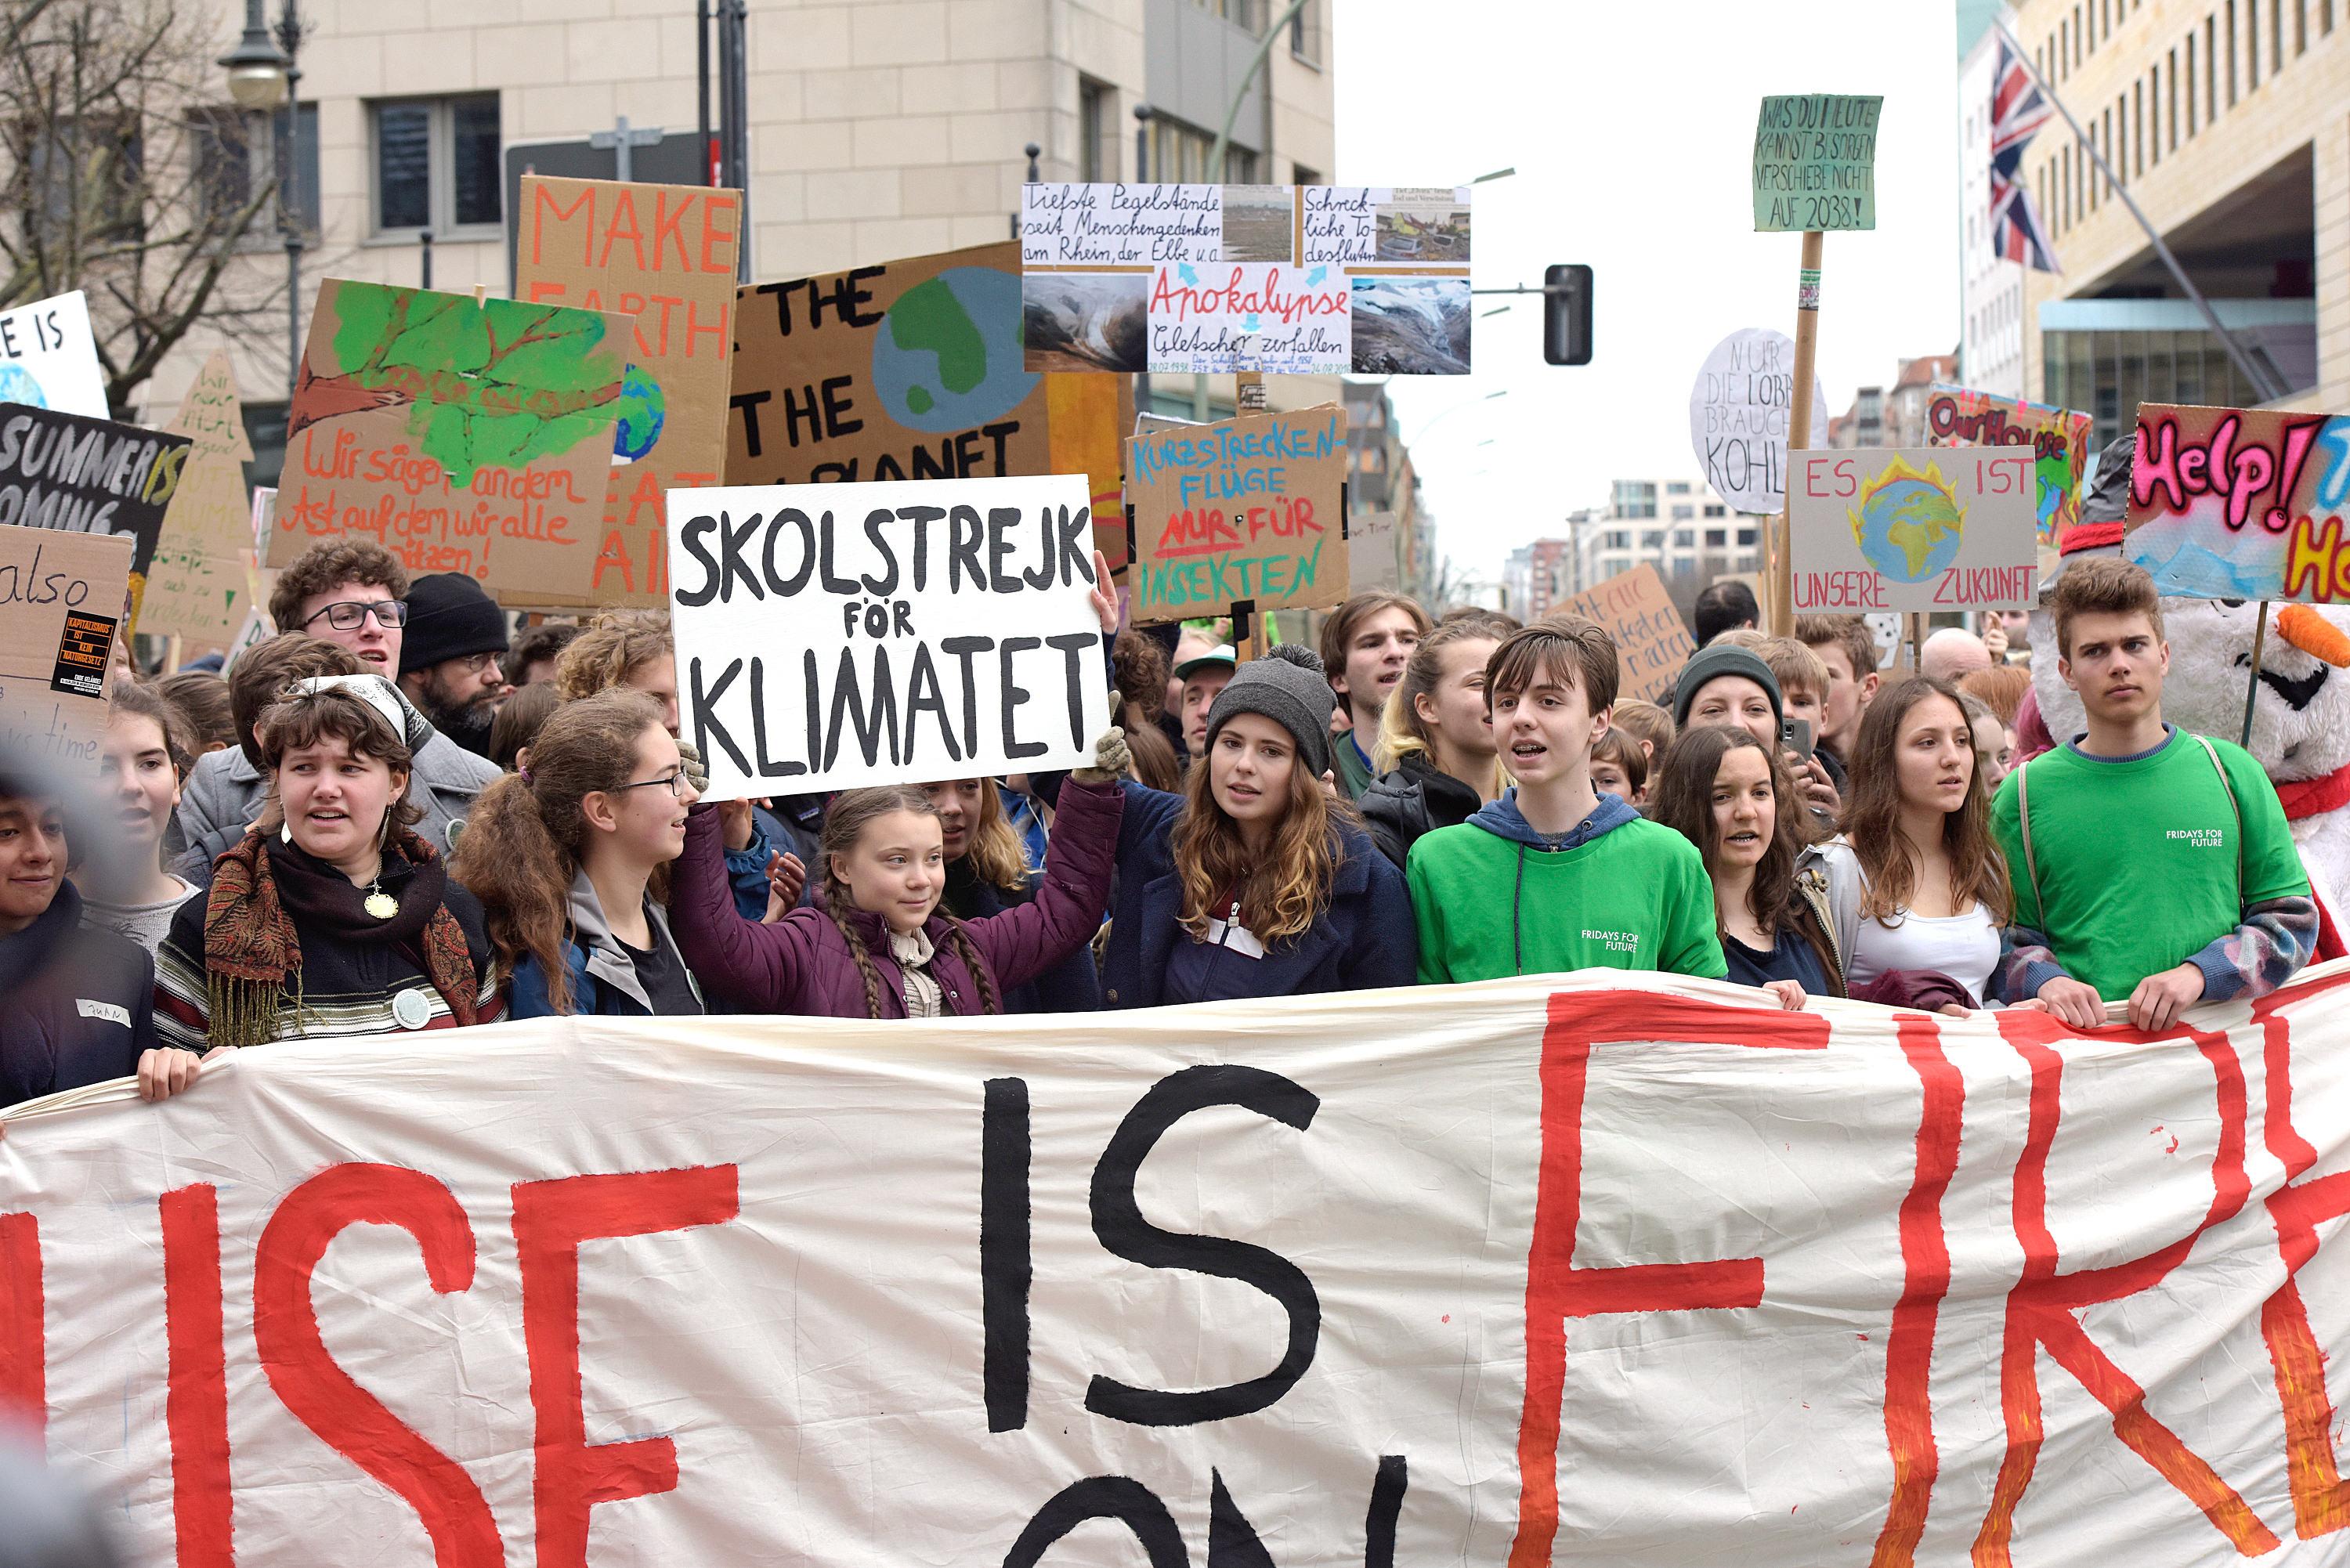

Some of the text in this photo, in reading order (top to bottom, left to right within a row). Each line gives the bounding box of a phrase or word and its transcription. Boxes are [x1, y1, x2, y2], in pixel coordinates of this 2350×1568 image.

[1763, 97, 1794, 128] WAS
[1798, 97, 1818, 128] DU
[1755, 131, 1875, 161] KANNST BESORGEN
[1755, 164, 1871, 191] VERSCHIEBE NICHT
[1023, 182, 1219, 216] Tiefste Pegelstände
[1304, 188, 1376, 212] Schreck-
[1770, 195, 1862, 228] AUF 2038!
[533, 183, 736, 274] MAKE
[1023, 210, 1219, 242] seit Menschengedenken
[1303, 214, 1376, 237] liche To-
[1024, 247, 1049, 262] am
[1059, 237, 1115, 265] Rhein,
[1118, 238, 1143, 261] der
[1152, 239, 1188, 262] Elbe
[1305, 239, 1376, 266] desfluten
[757, 265, 887, 337] THE
[1149, 266, 1348, 324] Apokalypse
[34, 310, 63, 352] IS
[1153, 325, 1342, 359] Gletscher zerfallen
[1730, 341, 1782, 374] NUR
[1705, 373, 1737, 405] DIE
[729, 374, 864, 457] THE
[1930, 397, 1986, 441] Our
[0, 414, 191, 507] SUMMER IS
[303, 428, 363, 480] Wir
[1133, 416, 1347, 486] KURZSTRECKEN-
[1180, 463, 1287, 508] FLÜGE
[1806, 457, 2036, 497] ES IST
[2131, 414, 2332, 536] Help!
[342, 494, 396, 543] auf
[394, 497, 446, 542] dem
[454, 501, 499, 537] wir
[501, 504, 580, 546] alle
[1158, 495, 1325, 549] NUR FÜR
[0, 543, 89, 607] also
[675, 504, 1096, 607] SKOLSTREJK
[1140, 537, 1324, 610] INSEKTEN
[1794, 565, 2038, 609] UNSERE ZUKUNFT
[68, 617, 110, 634] KAPITALISMUS
[74, 630, 83, 640] IST
[844, 597, 916, 639] FÖR
[63, 651, 101, 666] NATURGESETZ
[79, 642, 93, 653] KEIN
[690, 632, 1098, 779] KLIMATET
[45, 703, 98, 761] time
[2166, 829, 2222, 840] FRIDAYS FOR
[2191, 838, 2223, 847] FUTURE
[1582, 930, 1639, 943] FRIDAYS FOR
[1606, 941, 1637, 952] FUTURE
[980, 1064, 1321, 1434] IS
